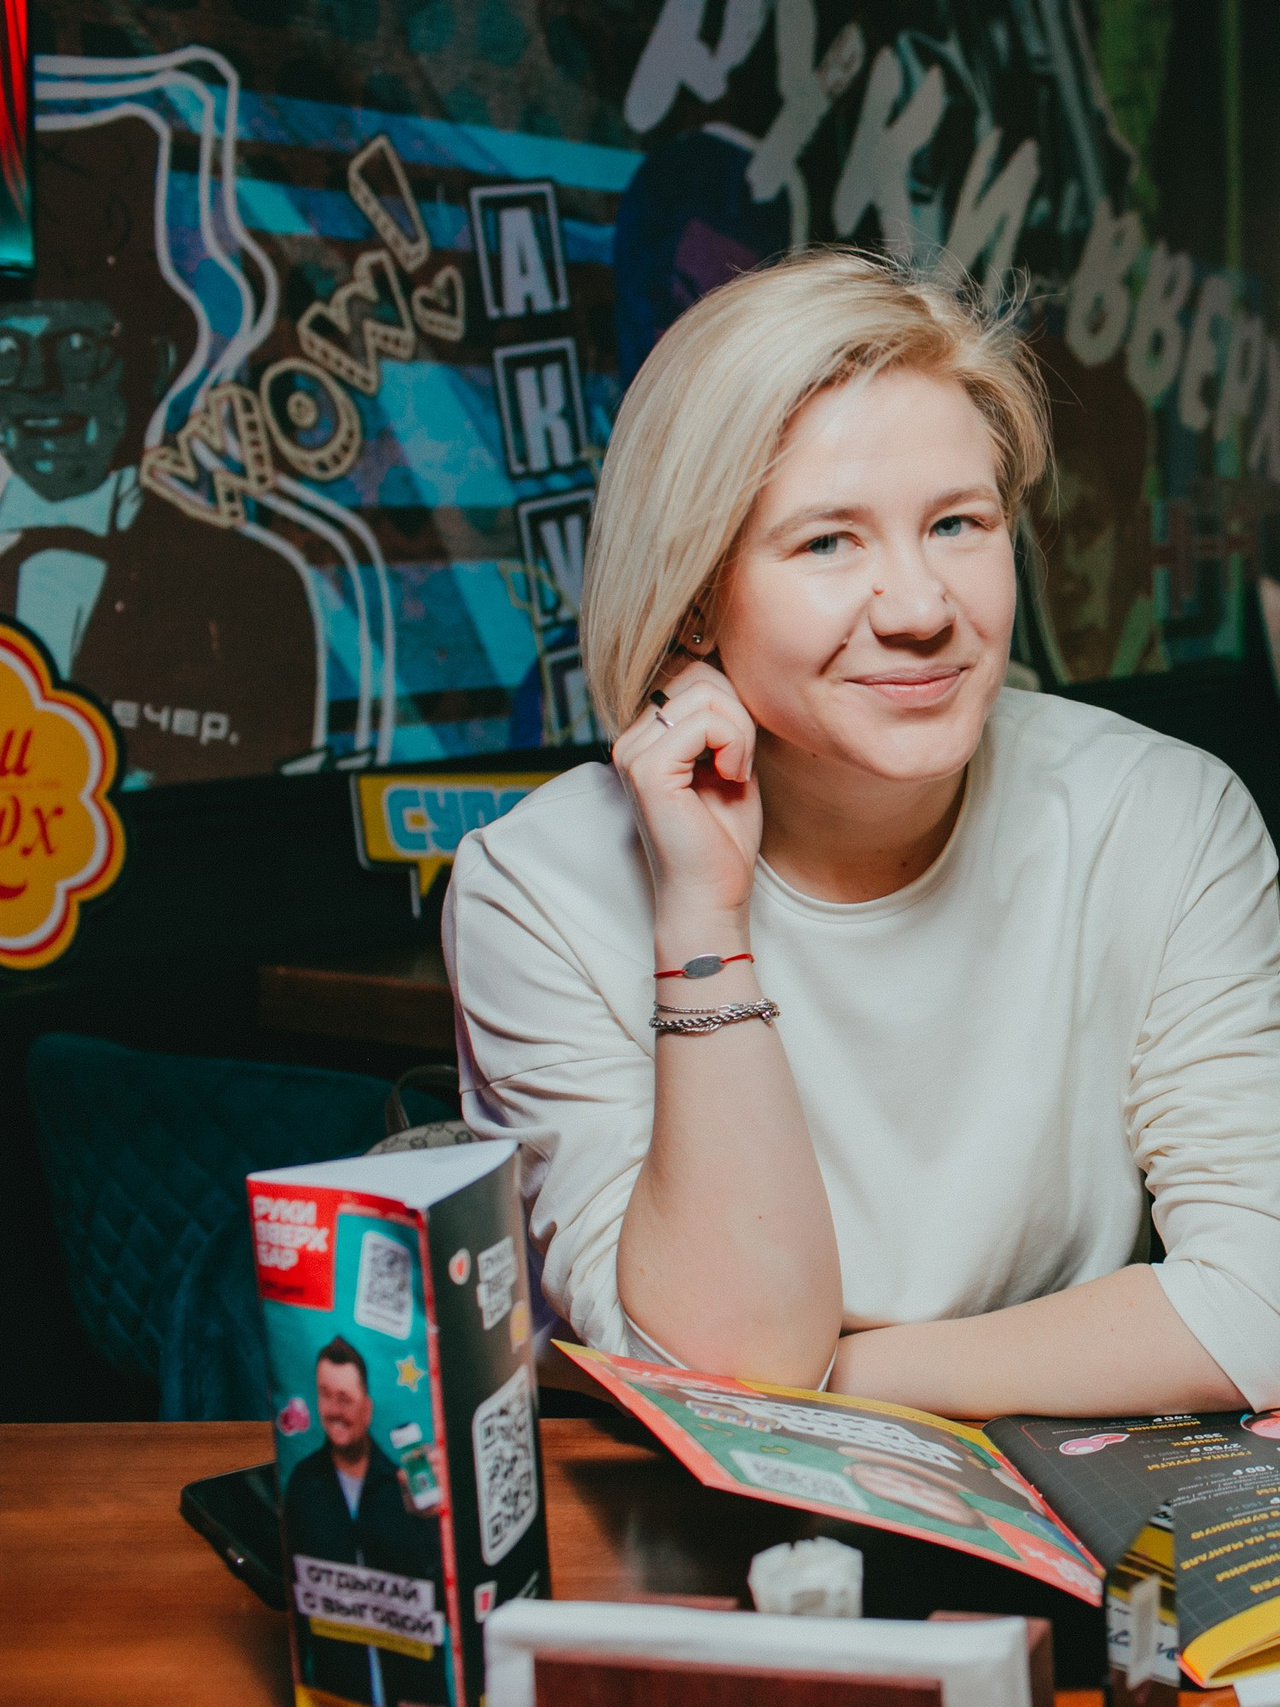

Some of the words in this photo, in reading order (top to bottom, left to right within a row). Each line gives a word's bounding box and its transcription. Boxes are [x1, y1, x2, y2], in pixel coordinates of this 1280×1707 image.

[1202, 1450, 1252, 1460] ГРУППА
[1145, 1456, 1203, 1470] ФРУКТЫ
[1244, 1464, 1275, 1473] 100
[306, 1565, 419, 1602] ОТДЫХАЙ
[322, 1596, 436, 1637] ВЫГОДОЙ
